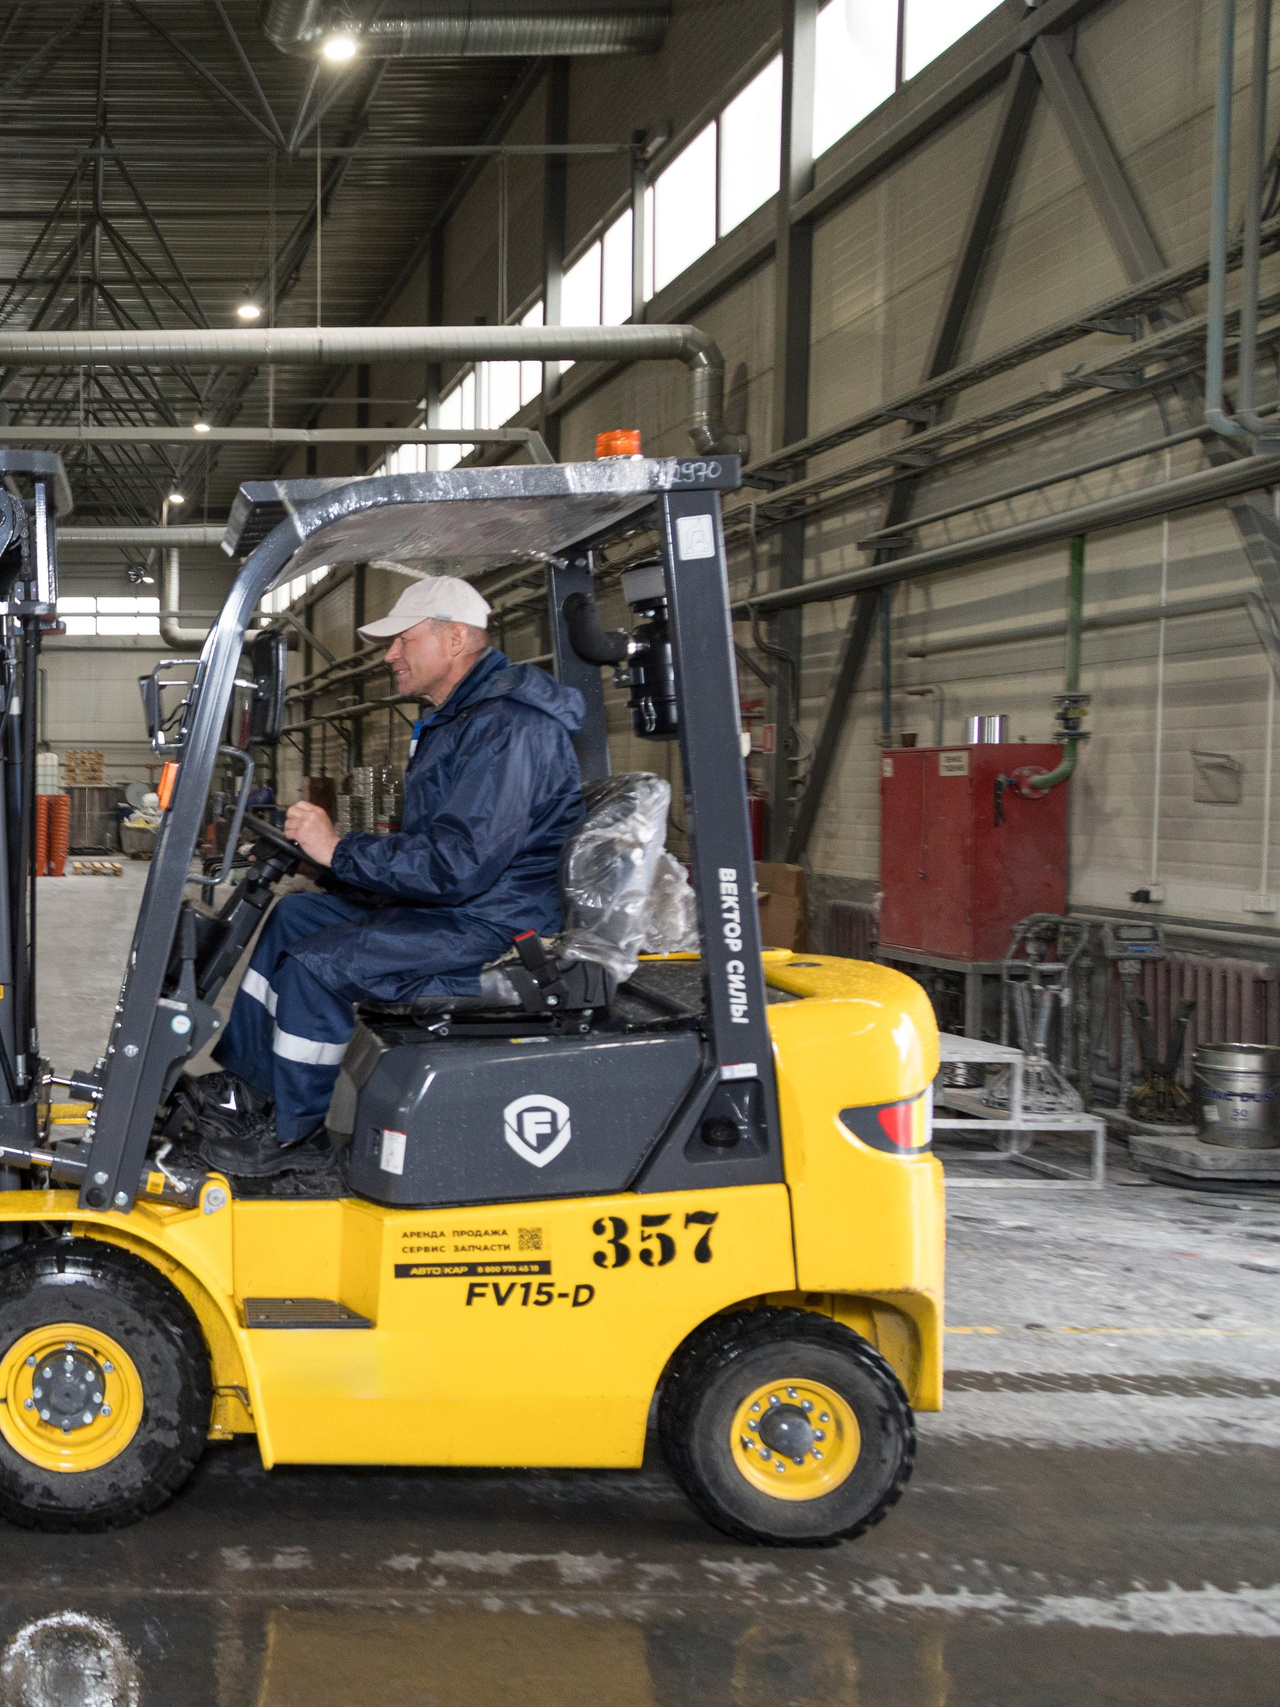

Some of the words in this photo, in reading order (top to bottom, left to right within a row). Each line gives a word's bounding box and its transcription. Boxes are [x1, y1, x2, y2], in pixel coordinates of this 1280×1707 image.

[718, 867, 743, 952] ВЕКТОР
[726, 959, 750, 1024] СИЛЫ
[402, 1230, 446, 1239] АРЕНДА
[452, 1229, 508, 1238] ПРОДАЖА
[592, 1210, 719, 1269] 357
[402, 1246, 446, 1254] СЕРВИС
[453, 1244, 511, 1253] ЗАПЧАСТИ
[485, 1265, 501, 1274] 800
[465, 1281, 595, 1308] FV15-D
